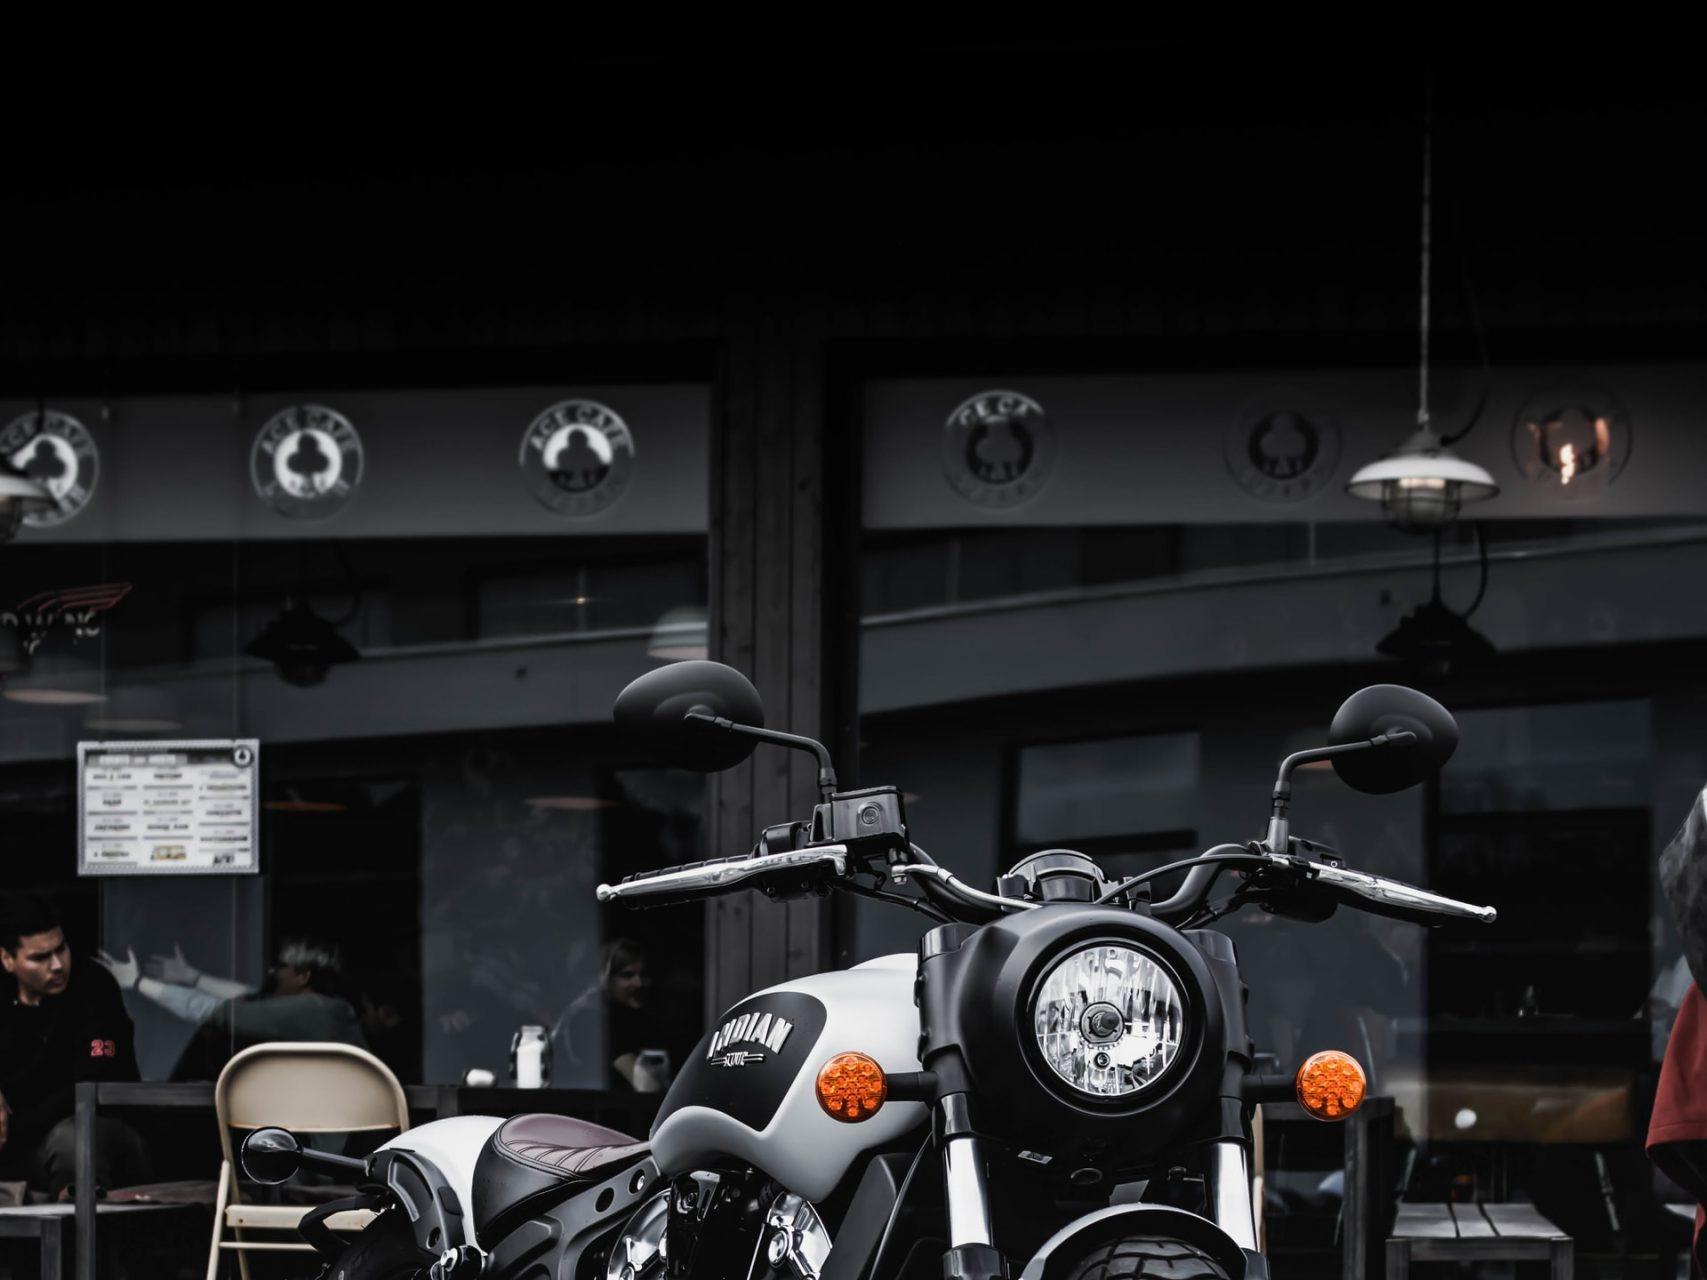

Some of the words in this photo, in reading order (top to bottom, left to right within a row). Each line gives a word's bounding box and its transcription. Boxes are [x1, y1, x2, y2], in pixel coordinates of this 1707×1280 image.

[307, 411, 357, 455] CAFE
[530, 408, 567, 450] ACE
[576, 406, 627, 450] CAFE
[706, 1012, 793, 1060] INDIAN
